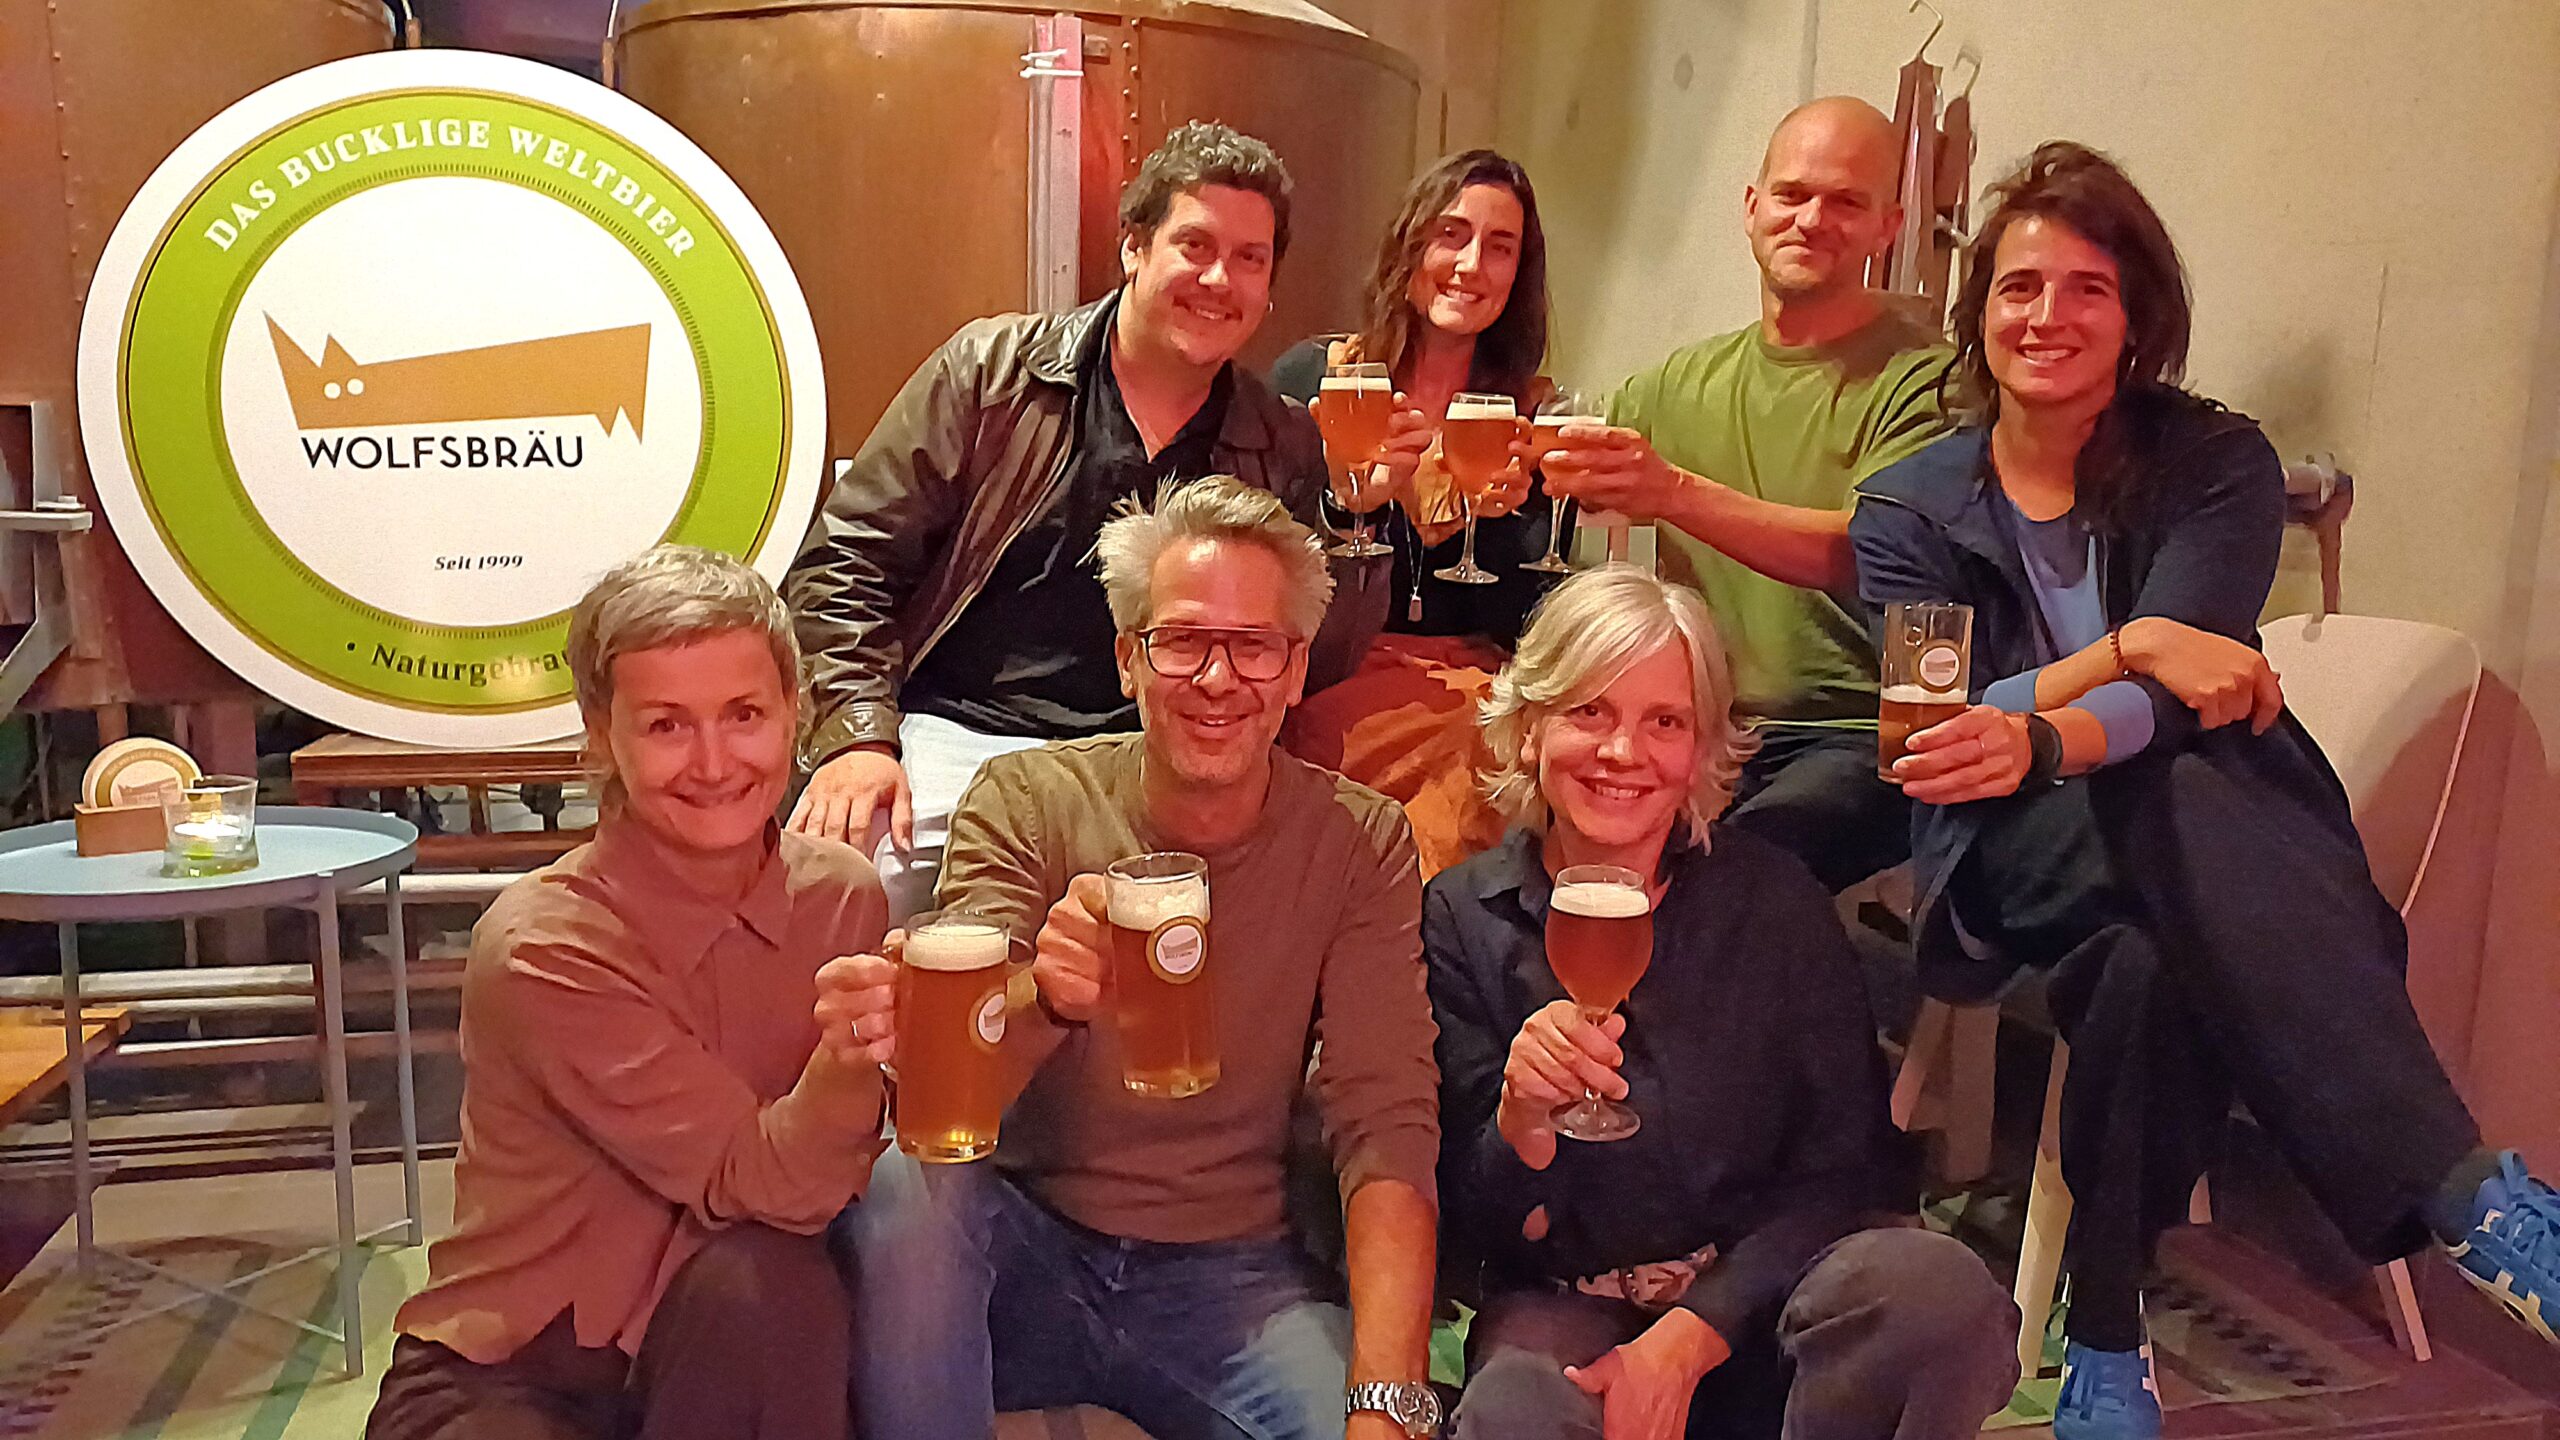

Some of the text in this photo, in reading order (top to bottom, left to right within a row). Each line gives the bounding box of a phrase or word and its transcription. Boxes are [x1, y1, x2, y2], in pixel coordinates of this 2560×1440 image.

[203, 118, 696, 258] DAS BUCKLIGE WELTBIER
[300, 430, 584, 470] WOLFSBRÄU
[434, 554, 524, 571] Seit 1999
